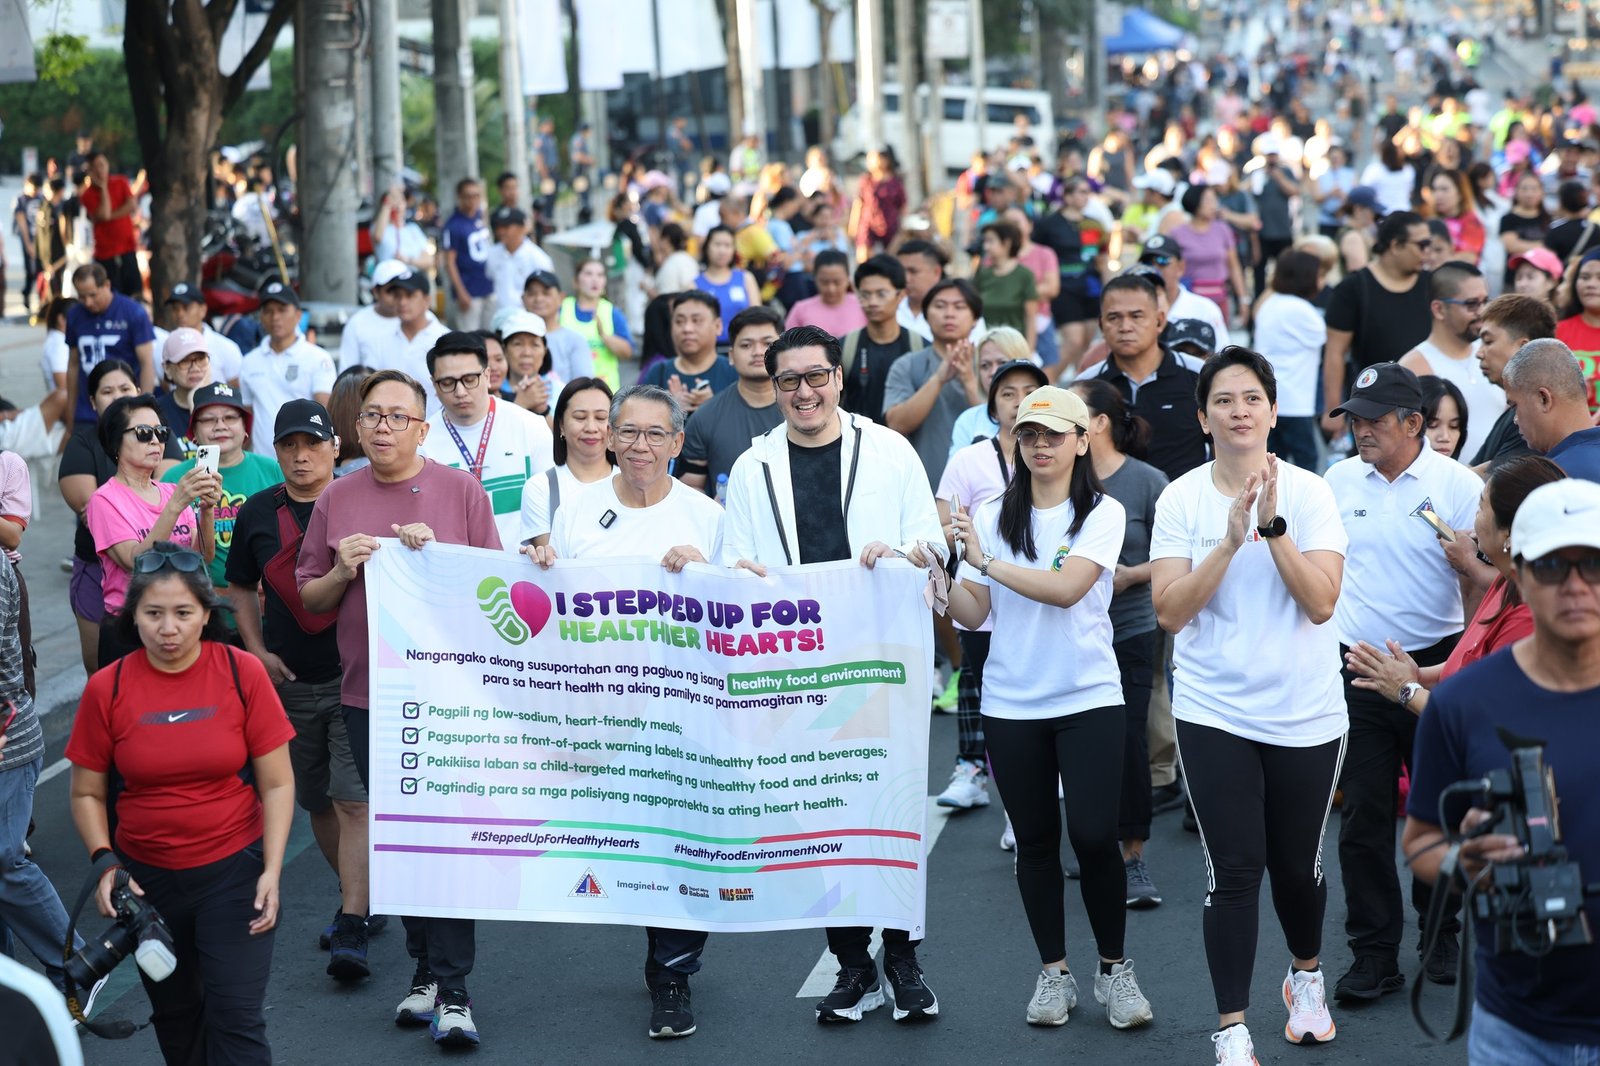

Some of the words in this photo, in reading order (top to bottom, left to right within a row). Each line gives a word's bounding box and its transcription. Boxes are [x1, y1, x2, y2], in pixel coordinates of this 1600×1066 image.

[555, 592, 566, 616] I
[573, 589, 703, 623] STEPPED
[707, 600, 744, 629] UP
[751, 599, 822, 628] FOR
[559, 619, 701, 650] HEALTHIER
[705, 628, 825, 657] HEARTS!
[406, 648, 487, 664] Nangangako
[489, 653, 524, 671] akong
[528, 659, 611, 675] susuportahan
[615, 665, 639, 677] ang
[642, 664, 684, 681] pagbuo
[686, 671, 698, 684] ng
[700, 671, 725, 691] isang
[732, 676, 782, 694] healthy
[785, 672, 818, 686] food
[822, 666, 902, 683] environment
[482, 673, 510, 686] para
[512, 678, 526, 688] sa
[528, 677, 562, 691] heart
[565, 679, 604, 693] health
[607, 683, 625, 695] ng
[627, 683, 661, 698] aking
[663, 687, 701, 704] pamilya
[703, 695, 714, 705] sa
[715, 695, 803, 710] pamamagitan
[806, 692, 827, 706] ng:
[428, 705, 470, 720] Pagpili
[473, 708, 489, 721] ng
[492, 707, 562, 726] low-sodium,
[565, 714, 647, 731] heart-friendly
[650, 720, 683, 735] meals;
[427, 731, 500, 745] Pagsuporta
[503, 734, 518, 745] sa
[521, 734, 602, 751] front-of-pack
[605, 740, 652, 755] warning
[655, 743, 684, 760] labels
[685, 751, 697, 762] sa
[699, 753, 753, 769] unhealthy
[756, 753, 787, 767] food
[790, 751, 816, 763] and
[818, 747, 888, 761] beverages;
[427, 755, 481, 769] Pakikiisa
[483, 757, 519, 770] laban
[522, 760, 537, 771] sa
[540, 759, 626, 777] child-targeted
[629, 767, 683, 785] marketing
[684, 776, 698, 789] ng
[700, 778, 756, 793] unhealthy
[759, 777, 789, 790] food
[793, 775, 817, 787] and
[820, 771, 862, 785] drinks;
[866, 771, 879, 782] at
[426, 781, 486, 796] Pagtindig
[489, 785, 518, 796] para
[521, 785, 536, 795] sa
[539, 786, 567, 799] mga
[571, 786, 630, 803] polisiyang
[633, 793, 709, 813] nagpoprotekta
[712, 805, 725, 815] sa
[728, 803, 761, 817] ating
[764, 801, 800, 814] heart
[803, 796, 848, 811] health.
[471, 830, 640, 849] #ISteppedUpForHealthyHearts
[674, 843, 842, 861] #HealthyFoodEnvironmentNOW
